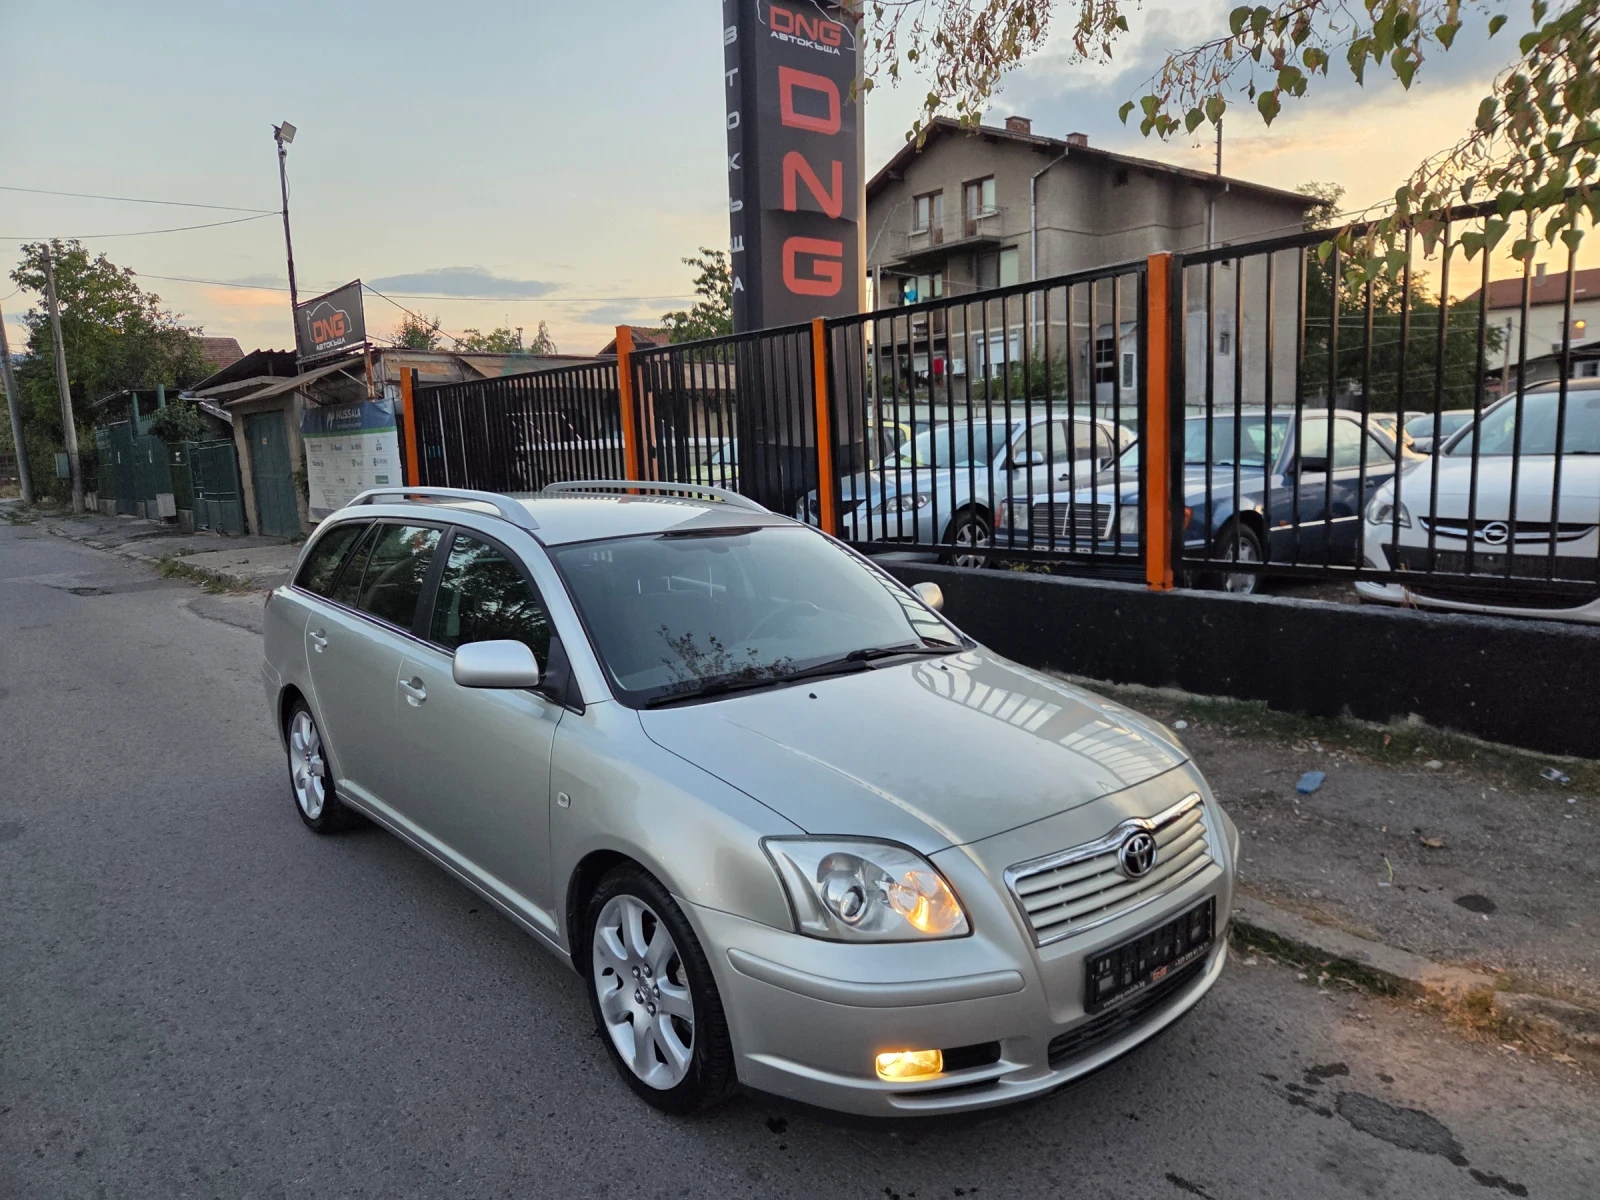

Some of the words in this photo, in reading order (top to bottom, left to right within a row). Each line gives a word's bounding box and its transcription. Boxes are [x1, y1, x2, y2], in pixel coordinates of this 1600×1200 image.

[769, 5, 842, 47] DNG
[778, 65, 843, 297] DNG
[312, 312, 345, 344] DNG
